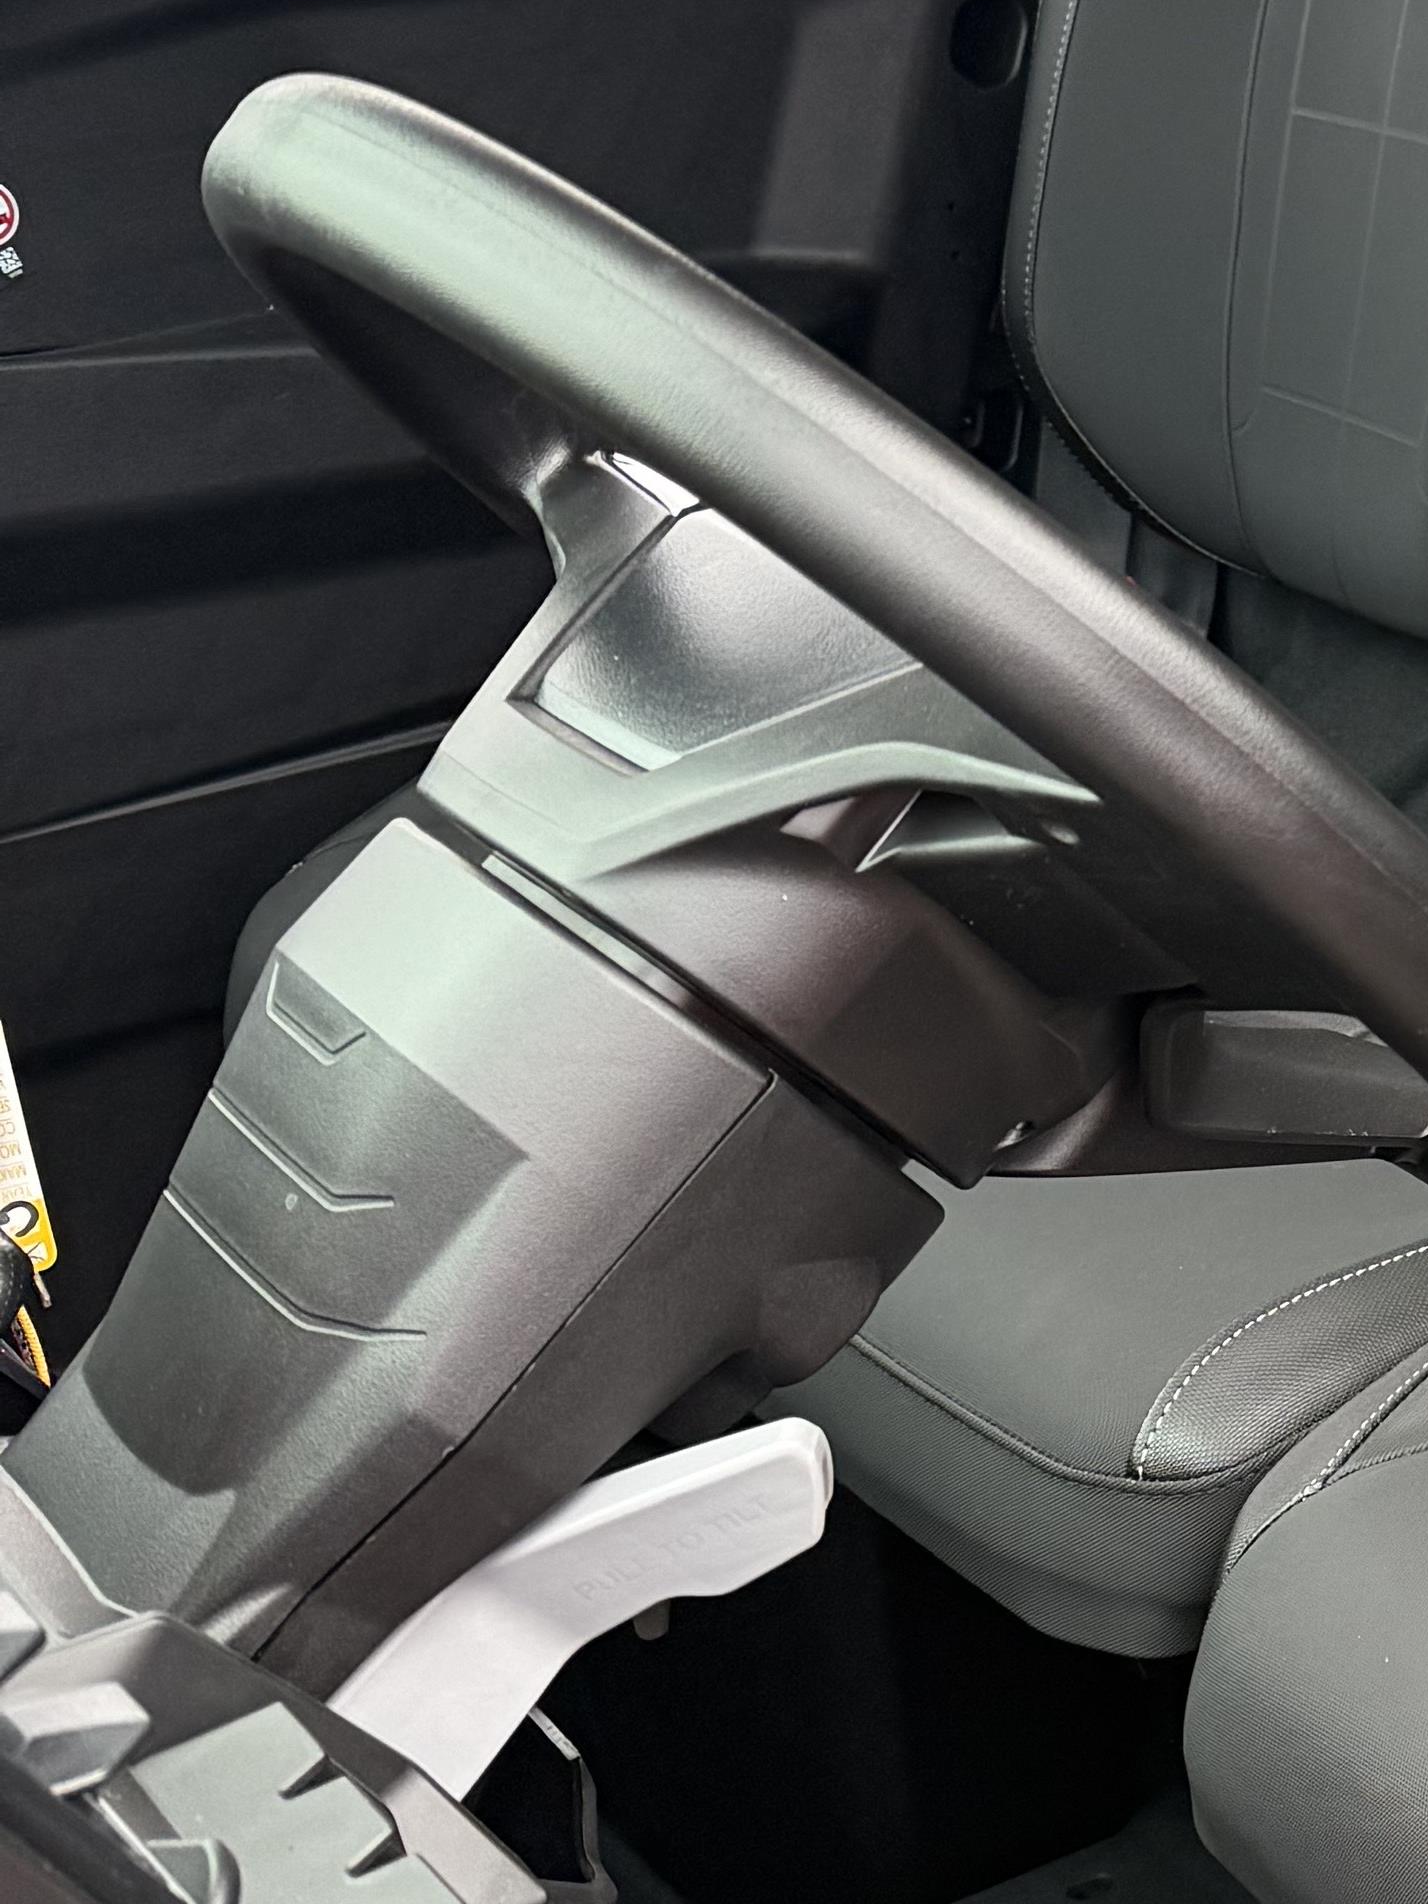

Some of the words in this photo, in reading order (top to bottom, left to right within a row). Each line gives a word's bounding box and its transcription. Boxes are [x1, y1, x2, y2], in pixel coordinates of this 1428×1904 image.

[574, 1557, 657, 1602] PULL
[657, 1531, 706, 1560] TO
[700, 1493, 773, 1534] TILT
